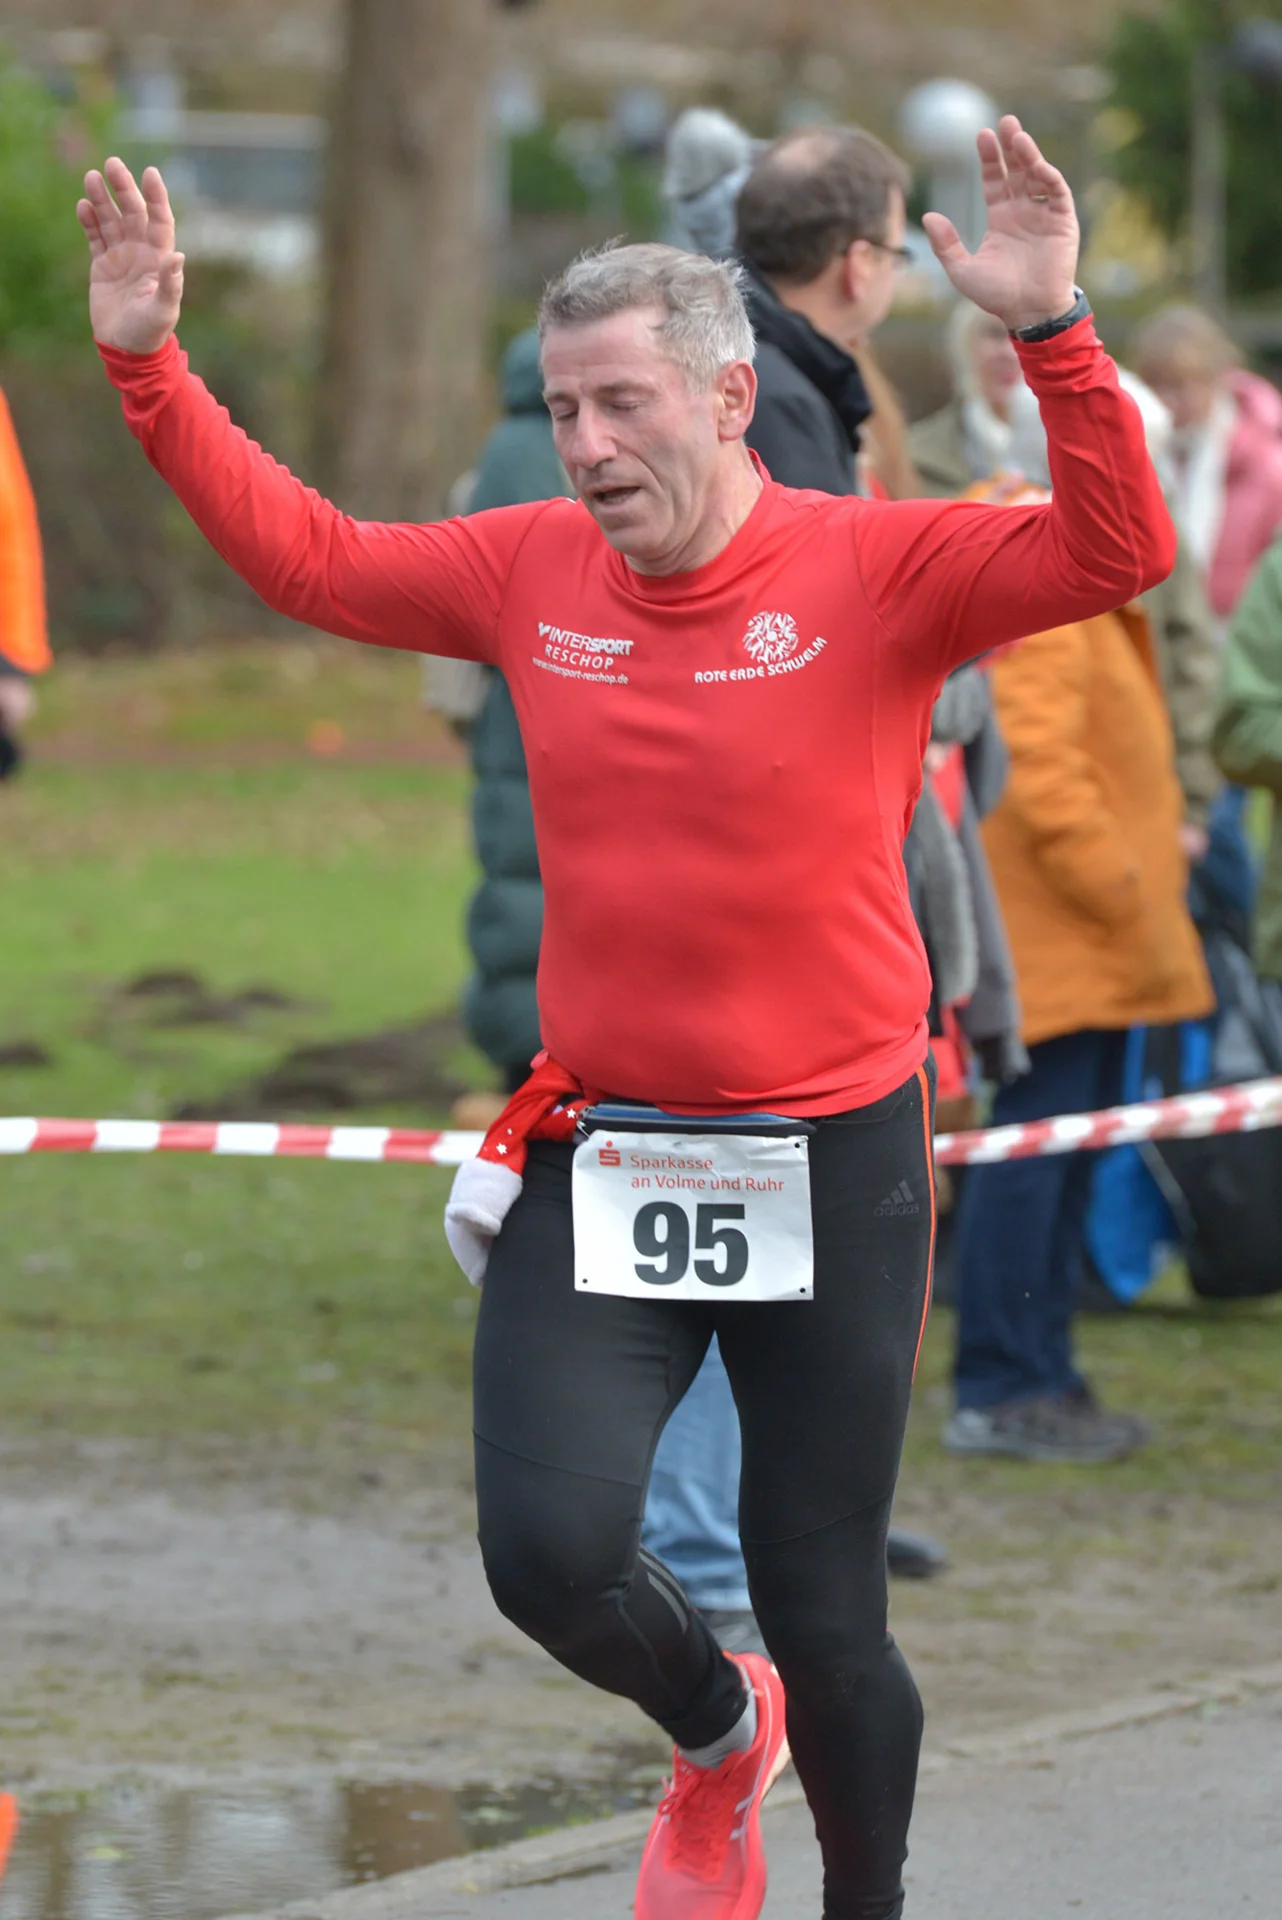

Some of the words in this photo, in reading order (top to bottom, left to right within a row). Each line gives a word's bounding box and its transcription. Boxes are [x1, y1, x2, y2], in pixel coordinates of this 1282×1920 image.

[548, 626, 634, 656] INTERSPORT
[544, 643, 614, 670] RESCHOP
[694, 670, 728, 684] ROTE
[729, 666, 765, 681] ERDE
[767, 636, 828, 677] SCHWELM
[630, 1155, 713, 1171] Sparkasse
[631, 1177, 651, 1189] an
[655, 1174, 706, 1190] Volme
[710, 1177, 741, 1191] und
[745, 1178, 785, 1192] Ruhr
[873, 1201, 920, 1217] adidas
[633, 1201, 749, 1287] 95
